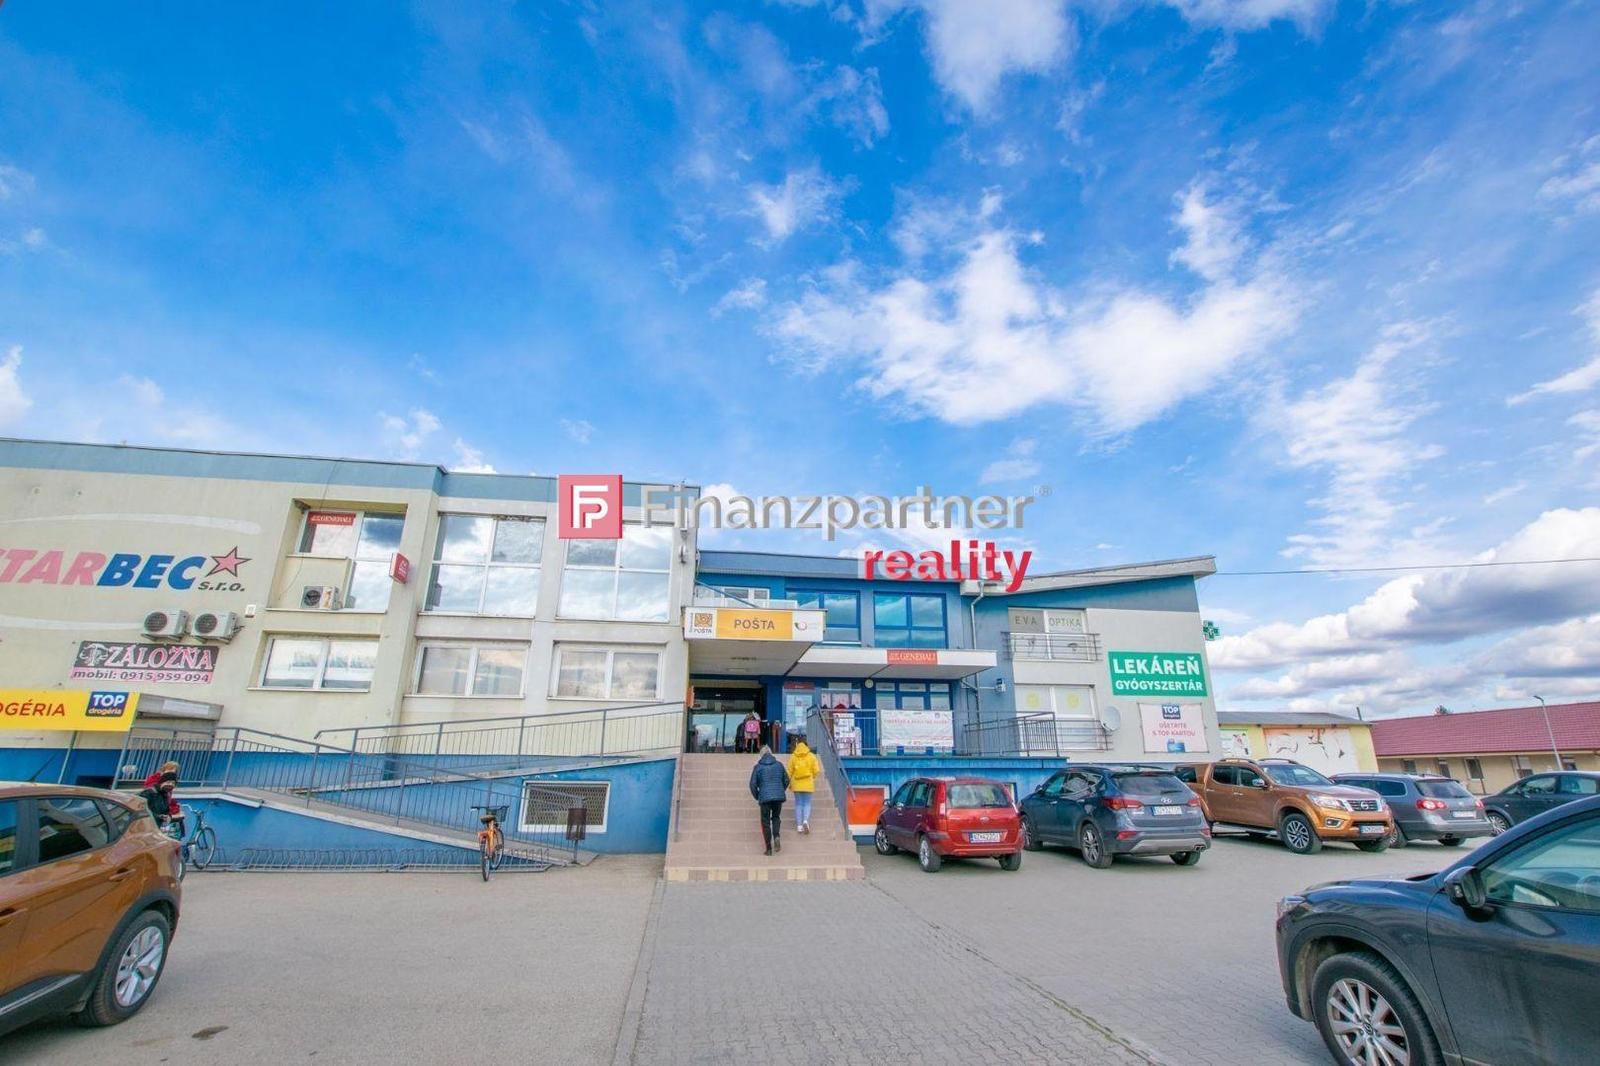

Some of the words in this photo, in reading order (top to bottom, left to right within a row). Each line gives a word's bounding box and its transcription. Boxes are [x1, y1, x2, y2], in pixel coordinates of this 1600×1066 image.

[197, 580, 245, 592] s.r.o.
[734, 616, 775, 631] POŠTA
[1048, 617, 1081, 628] OPTIKA
[104, 644, 214, 670] ZÁLOŽŇA
[900, 651, 936, 661] GENERALI
[1113, 655, 1200, 675] LEKÁREŇ
[73, 670, 117, 680] mobil:
[1115, 678, 1203, 691] GYÓGYSZERTÁR
[93, 694, 126, 707] TOP
[0, 699, 66, 716] GÉRIA
[88, 707, 122, 716] drogéria
[1162, 706, 1179, 714] TOP
